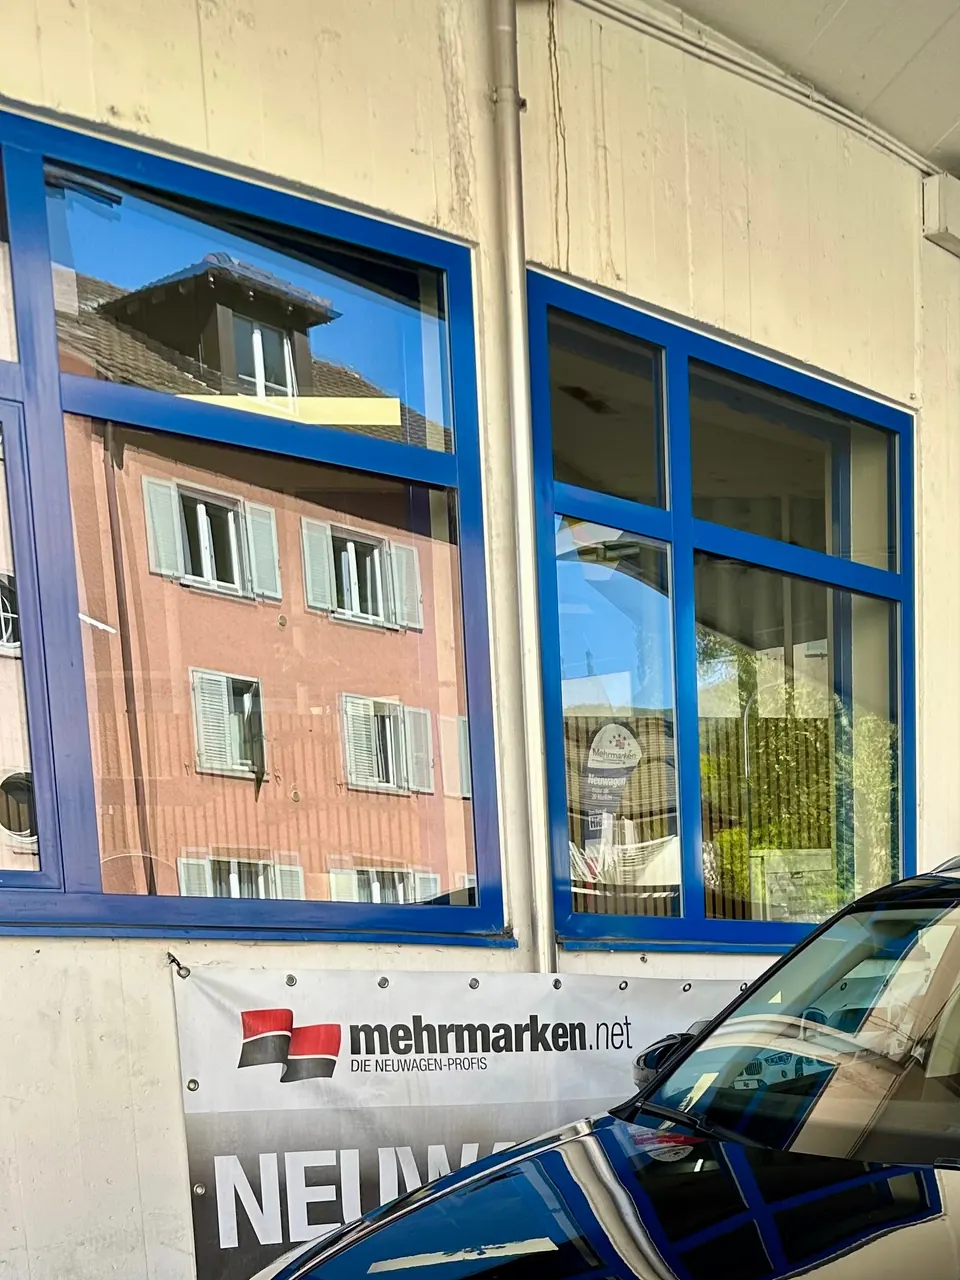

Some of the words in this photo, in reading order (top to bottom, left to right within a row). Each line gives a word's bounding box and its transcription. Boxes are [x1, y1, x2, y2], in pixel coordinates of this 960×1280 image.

[592, 747, 637, 761] Mehrmarken
[350, 1015, 633, 1055] mehrmarken.net
[351, 1059, 371, 1072] DIE
[375, 1056, 488, 1072] NEUWAGEN-PROFIS
[214, 1142, 516, 1248] NEU
